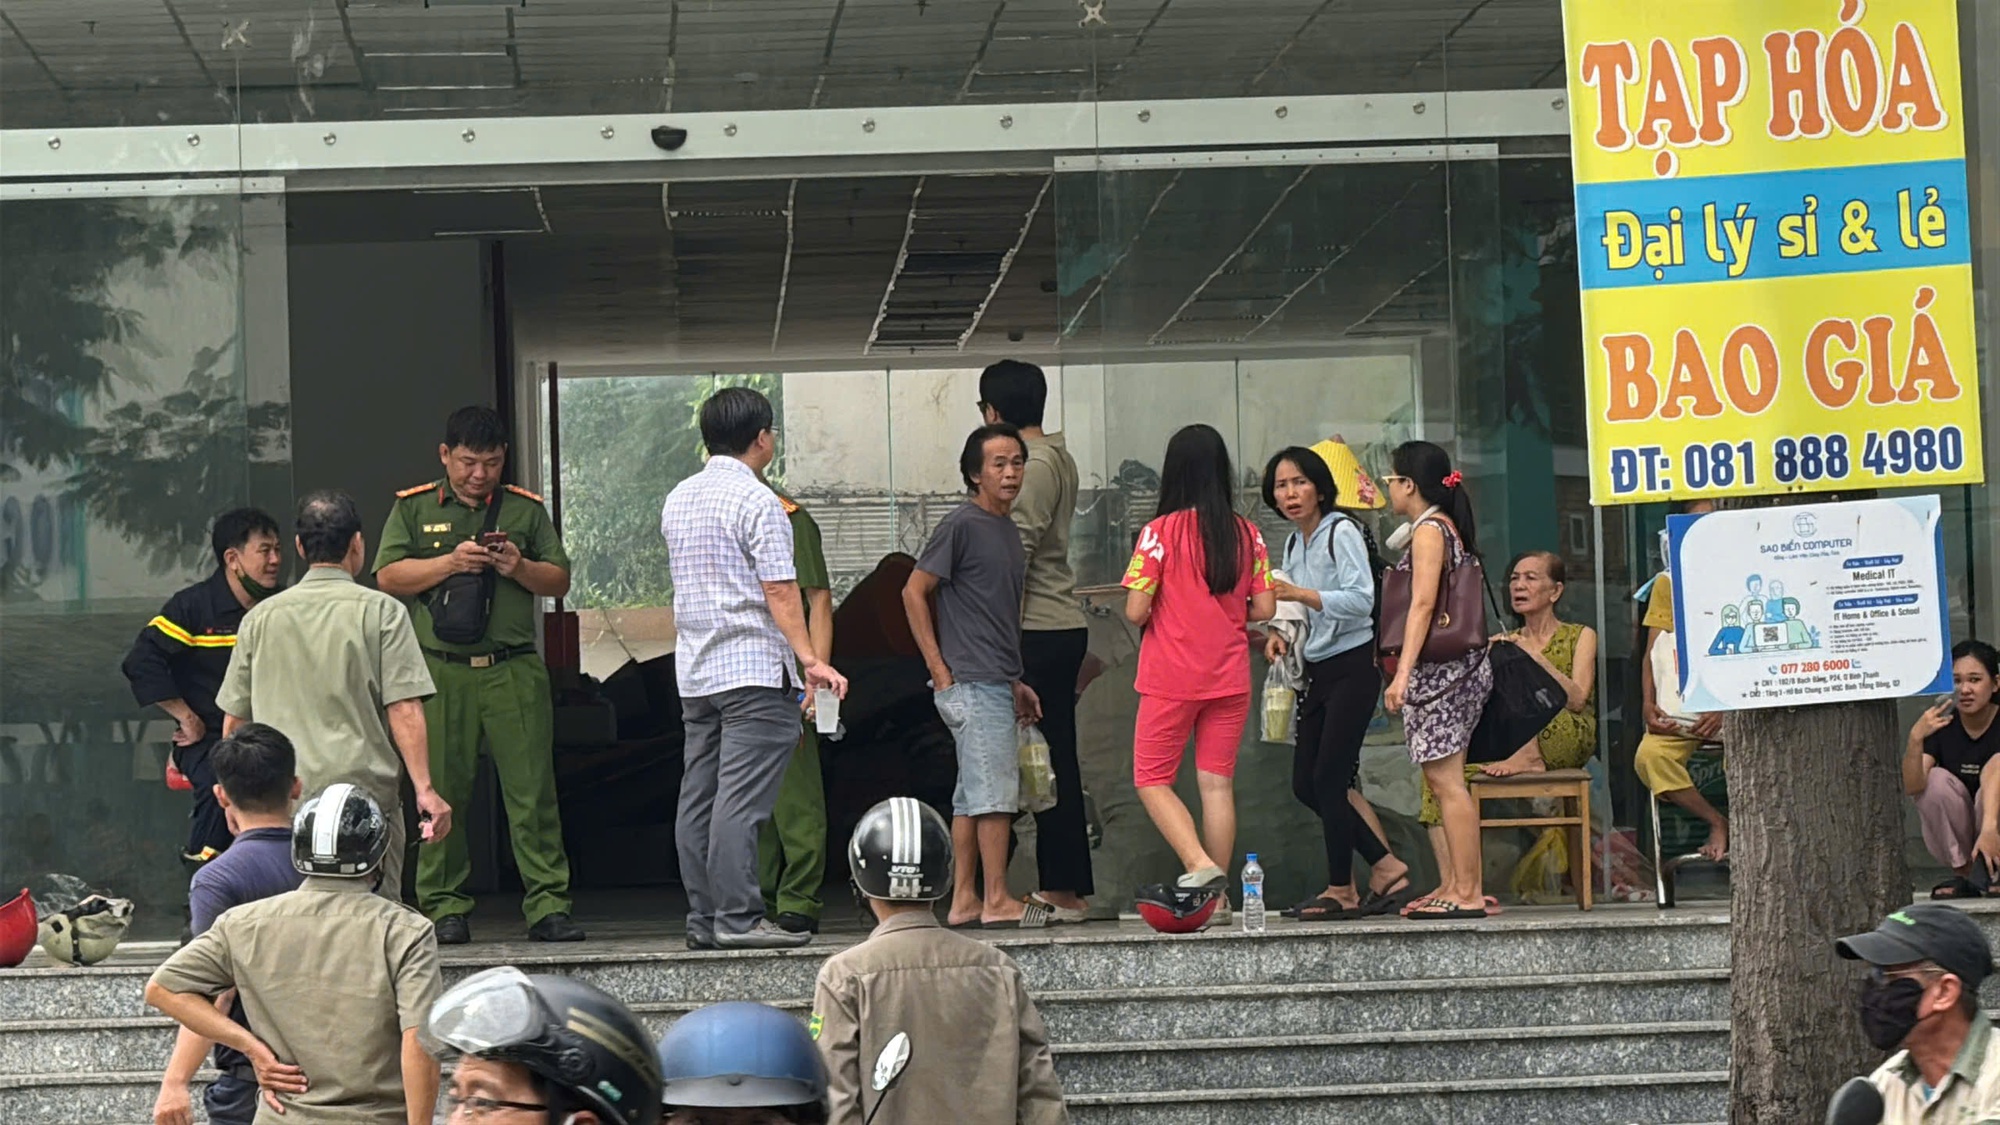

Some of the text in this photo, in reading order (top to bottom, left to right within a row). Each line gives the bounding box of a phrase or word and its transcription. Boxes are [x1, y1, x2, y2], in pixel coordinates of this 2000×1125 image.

[1582, 0, 1948, 178] TẠP HÓA
[1601, 186, 1947, 281] Đại lý sỉ & lẻ
[1601, 285, 1962, 422] BAO GIÁ
[1609, 425, 1964, 494] ĐT: 081 888 4980
[1760, 543, 1779, 554] SAO
[1802, 538, 1853, 551] COMPUTER
[1852, 568, 1896, 581] Medical IT
[1833, 607, 1920, 621] IT Home & Office & School
[1780, 659, 1850, 675] 077 280 6000
